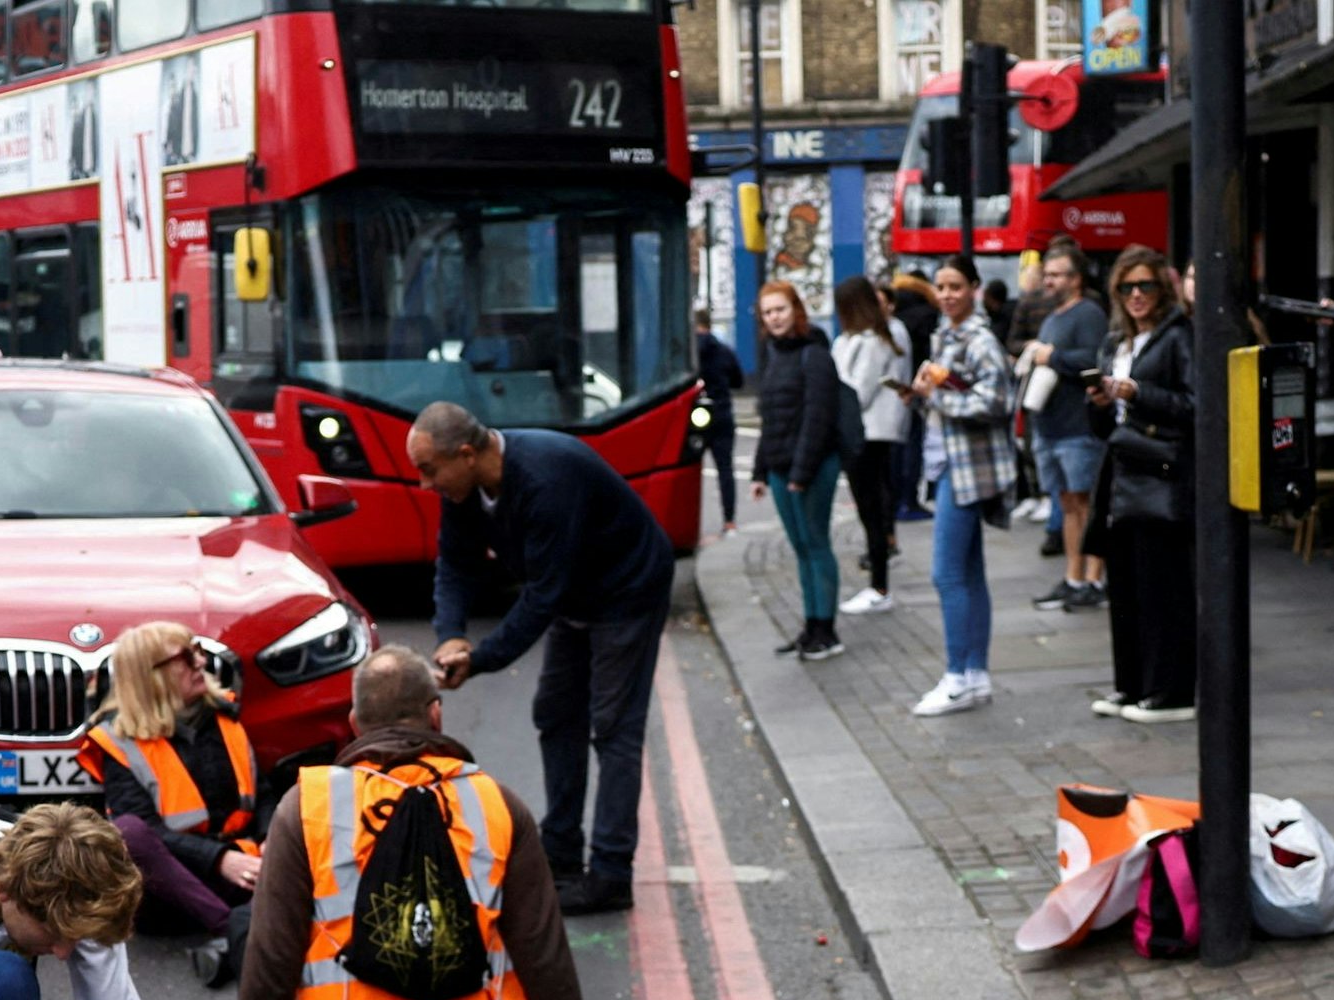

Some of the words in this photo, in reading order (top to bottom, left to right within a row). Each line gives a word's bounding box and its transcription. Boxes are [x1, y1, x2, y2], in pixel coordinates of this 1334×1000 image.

[1088, 47, 1142, 70] OPEN
[361, 80, 448, 109] Homerton
[453, 82, 528, 118] Hospital
[569, 78, 622, 128] 242
[19, 756, 101, 786] LX2
